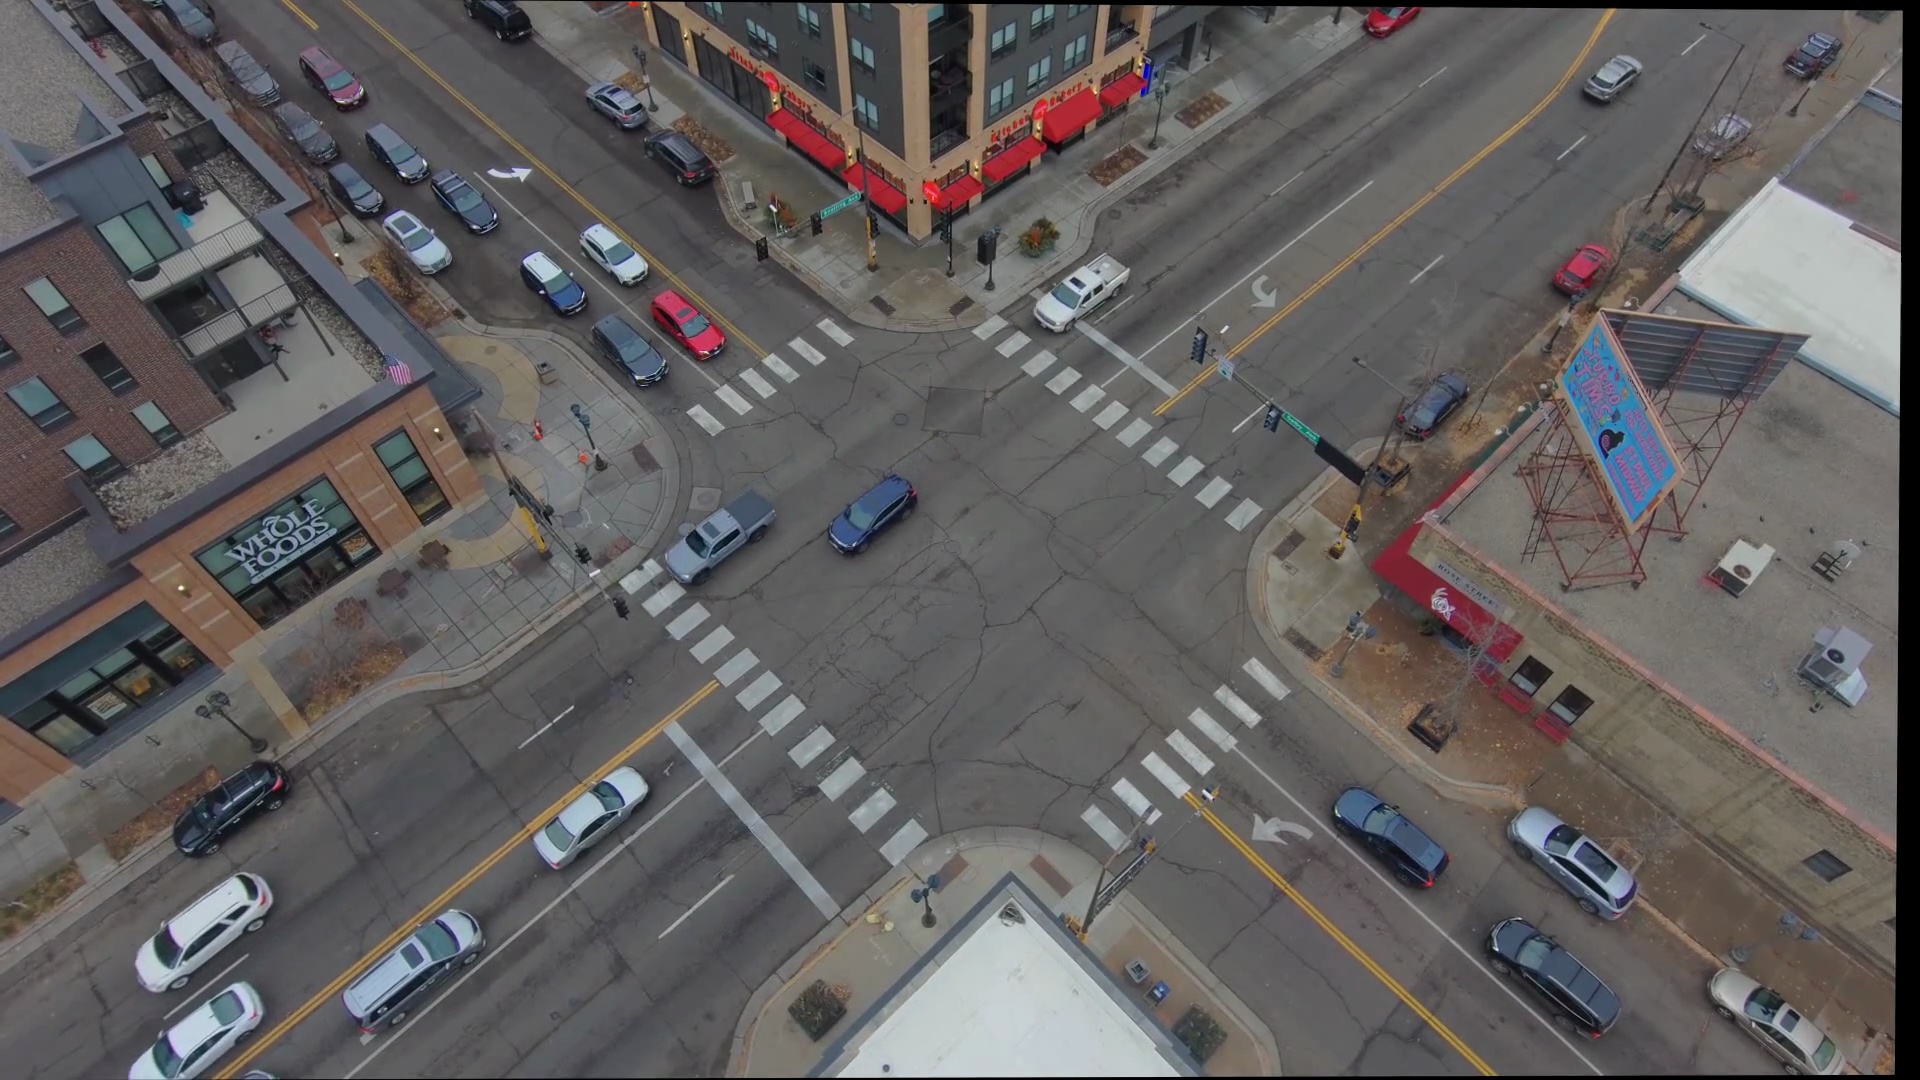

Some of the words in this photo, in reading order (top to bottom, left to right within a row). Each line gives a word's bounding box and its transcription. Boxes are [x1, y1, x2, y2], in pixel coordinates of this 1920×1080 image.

[1588, 351, 1620, 405] TURBO
[1615, 453, 1645, 502] MIDWAY
[224, 499, 326, 562] WHOLE
[241, 516, 329, 577] FOODS
